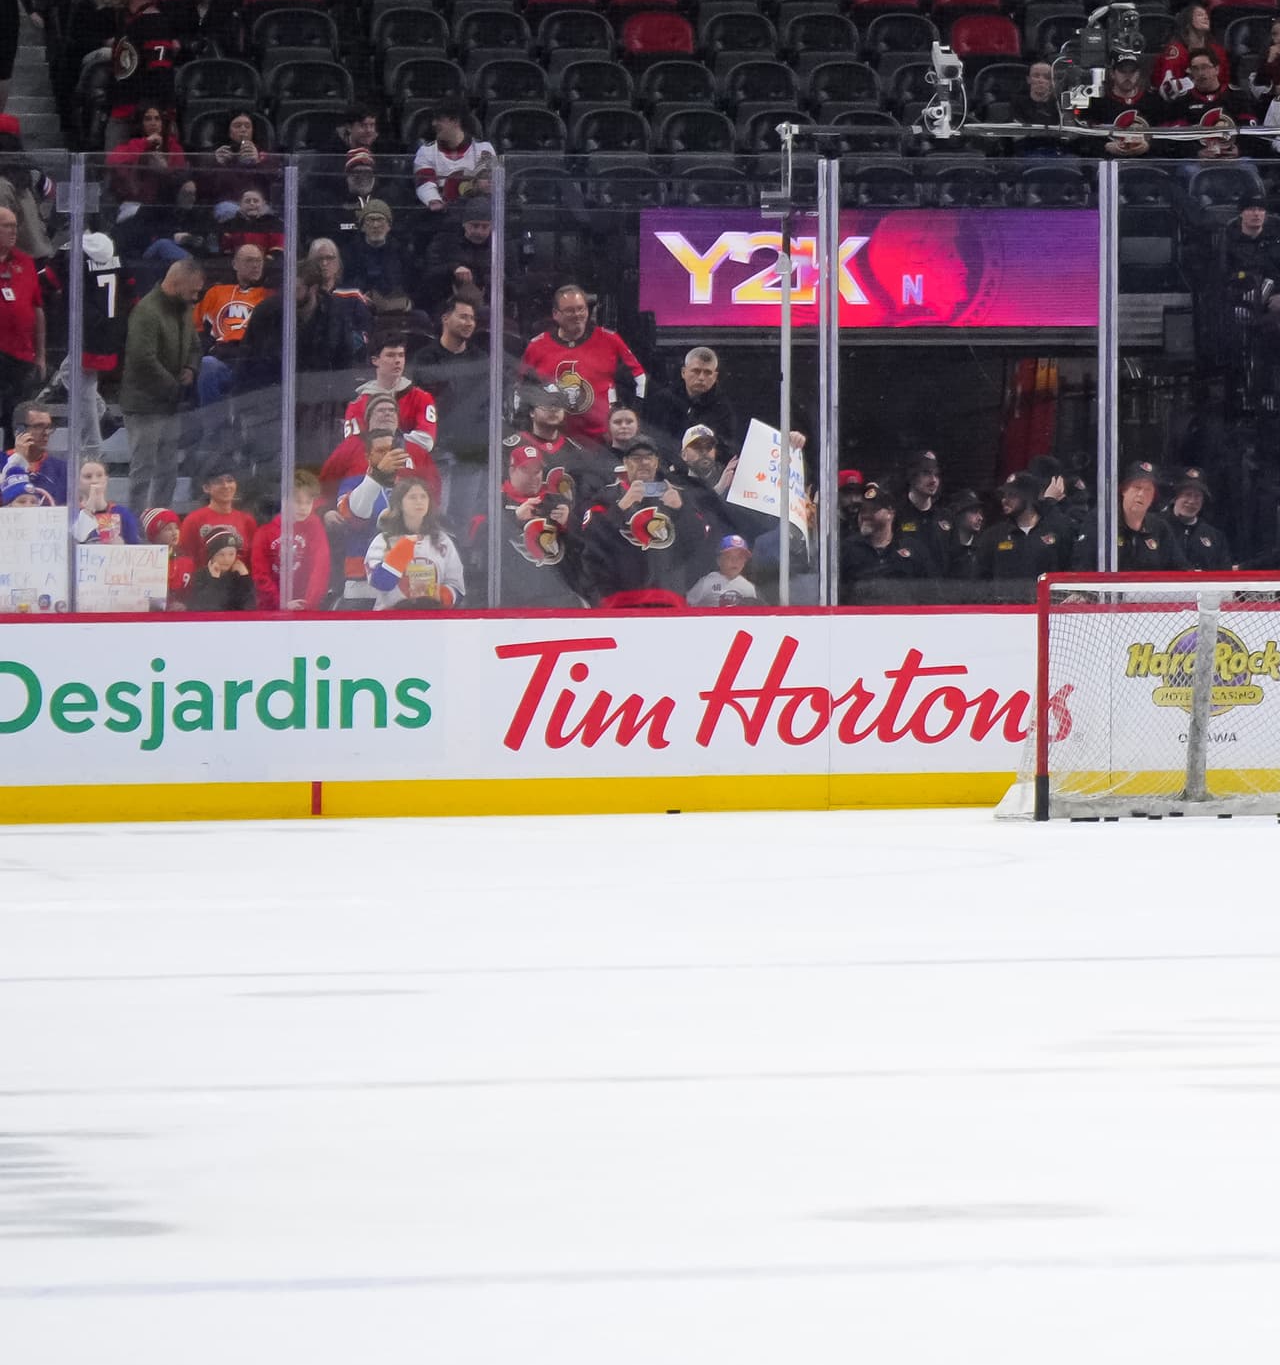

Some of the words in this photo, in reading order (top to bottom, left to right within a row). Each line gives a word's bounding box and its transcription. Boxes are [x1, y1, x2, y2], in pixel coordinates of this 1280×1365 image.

[96, 273, 117, 318] 7
[653, 230, 871, 306] Y2K
[0, 656, 433, 751] Desjardins
[495, 637, 677, 751] Tim
[695, 629, 1074, 748] Hortons
[1160, 691, 1193, 702] HOTE
[1178, 732, 1238, 743] OAWA
